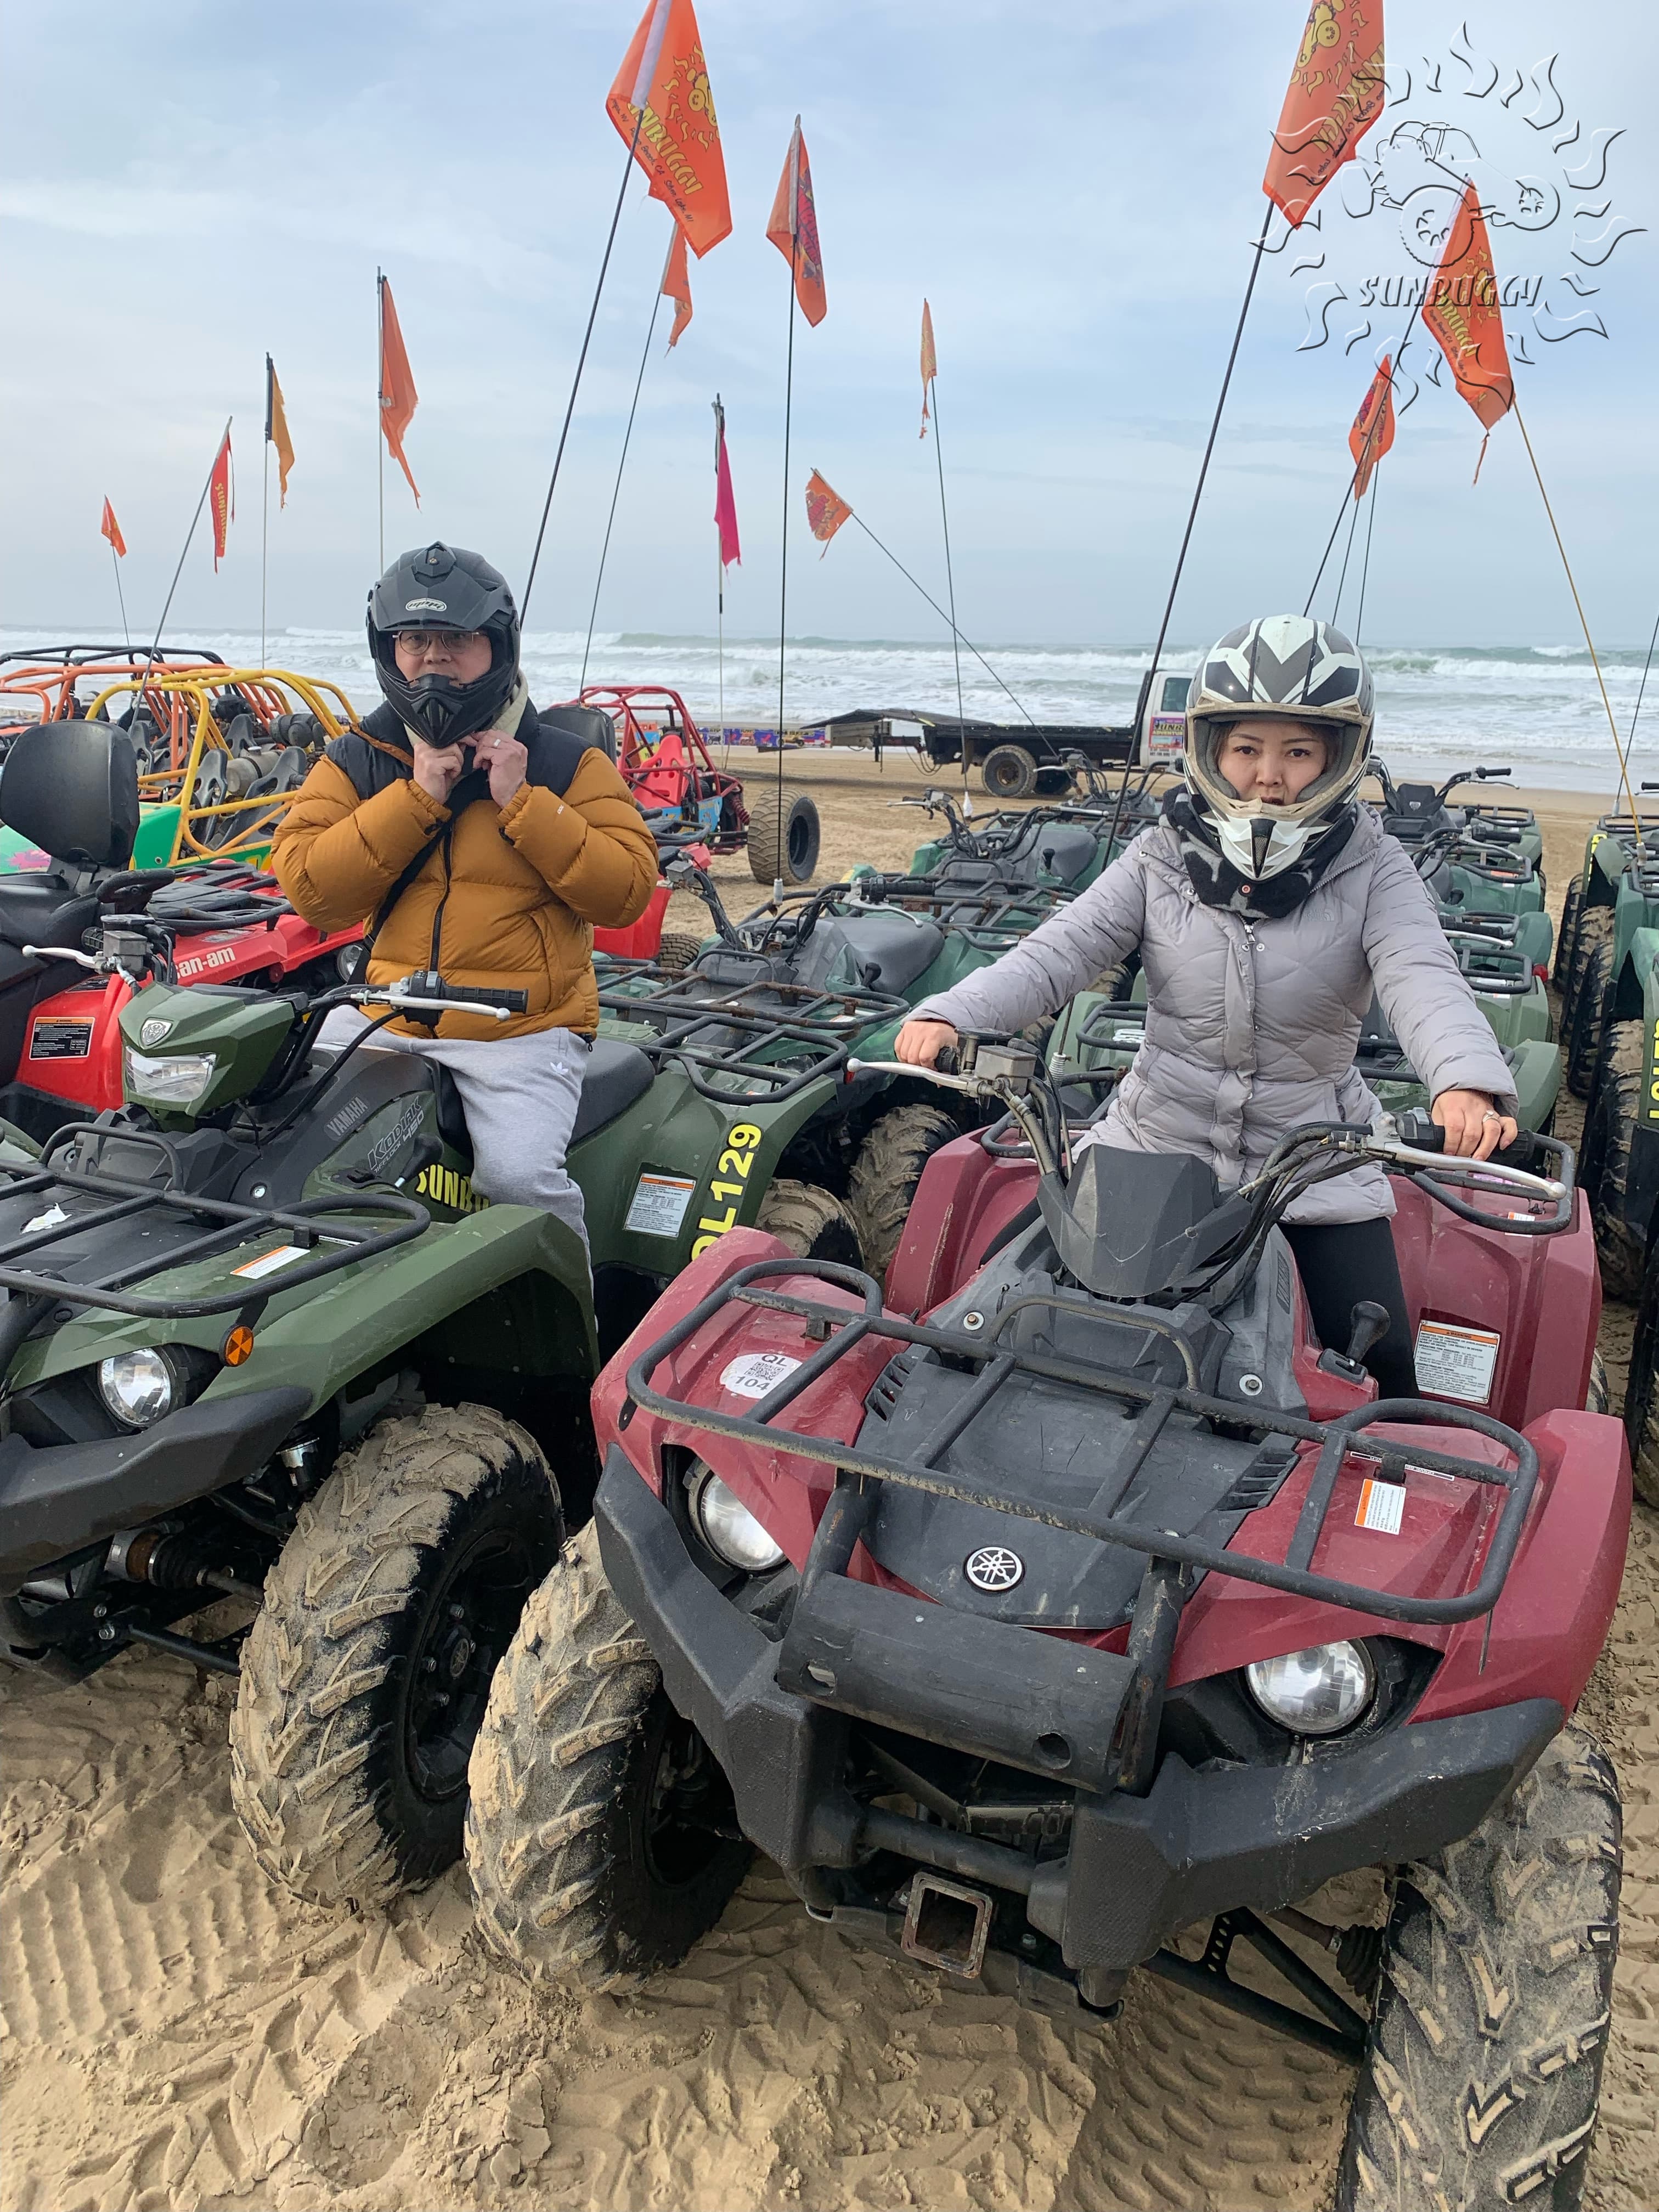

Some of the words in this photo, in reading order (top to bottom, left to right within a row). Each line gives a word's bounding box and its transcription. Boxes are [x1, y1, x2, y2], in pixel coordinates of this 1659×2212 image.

[327, 1097, 368, 1136] YAMAHA
[368, 1095, 422, 1170] KODIAK
[402, 1109, 425, 1142] 450
[761, 1355, 787, 1367] QL
[735, 1376, 770, 1391] 104
